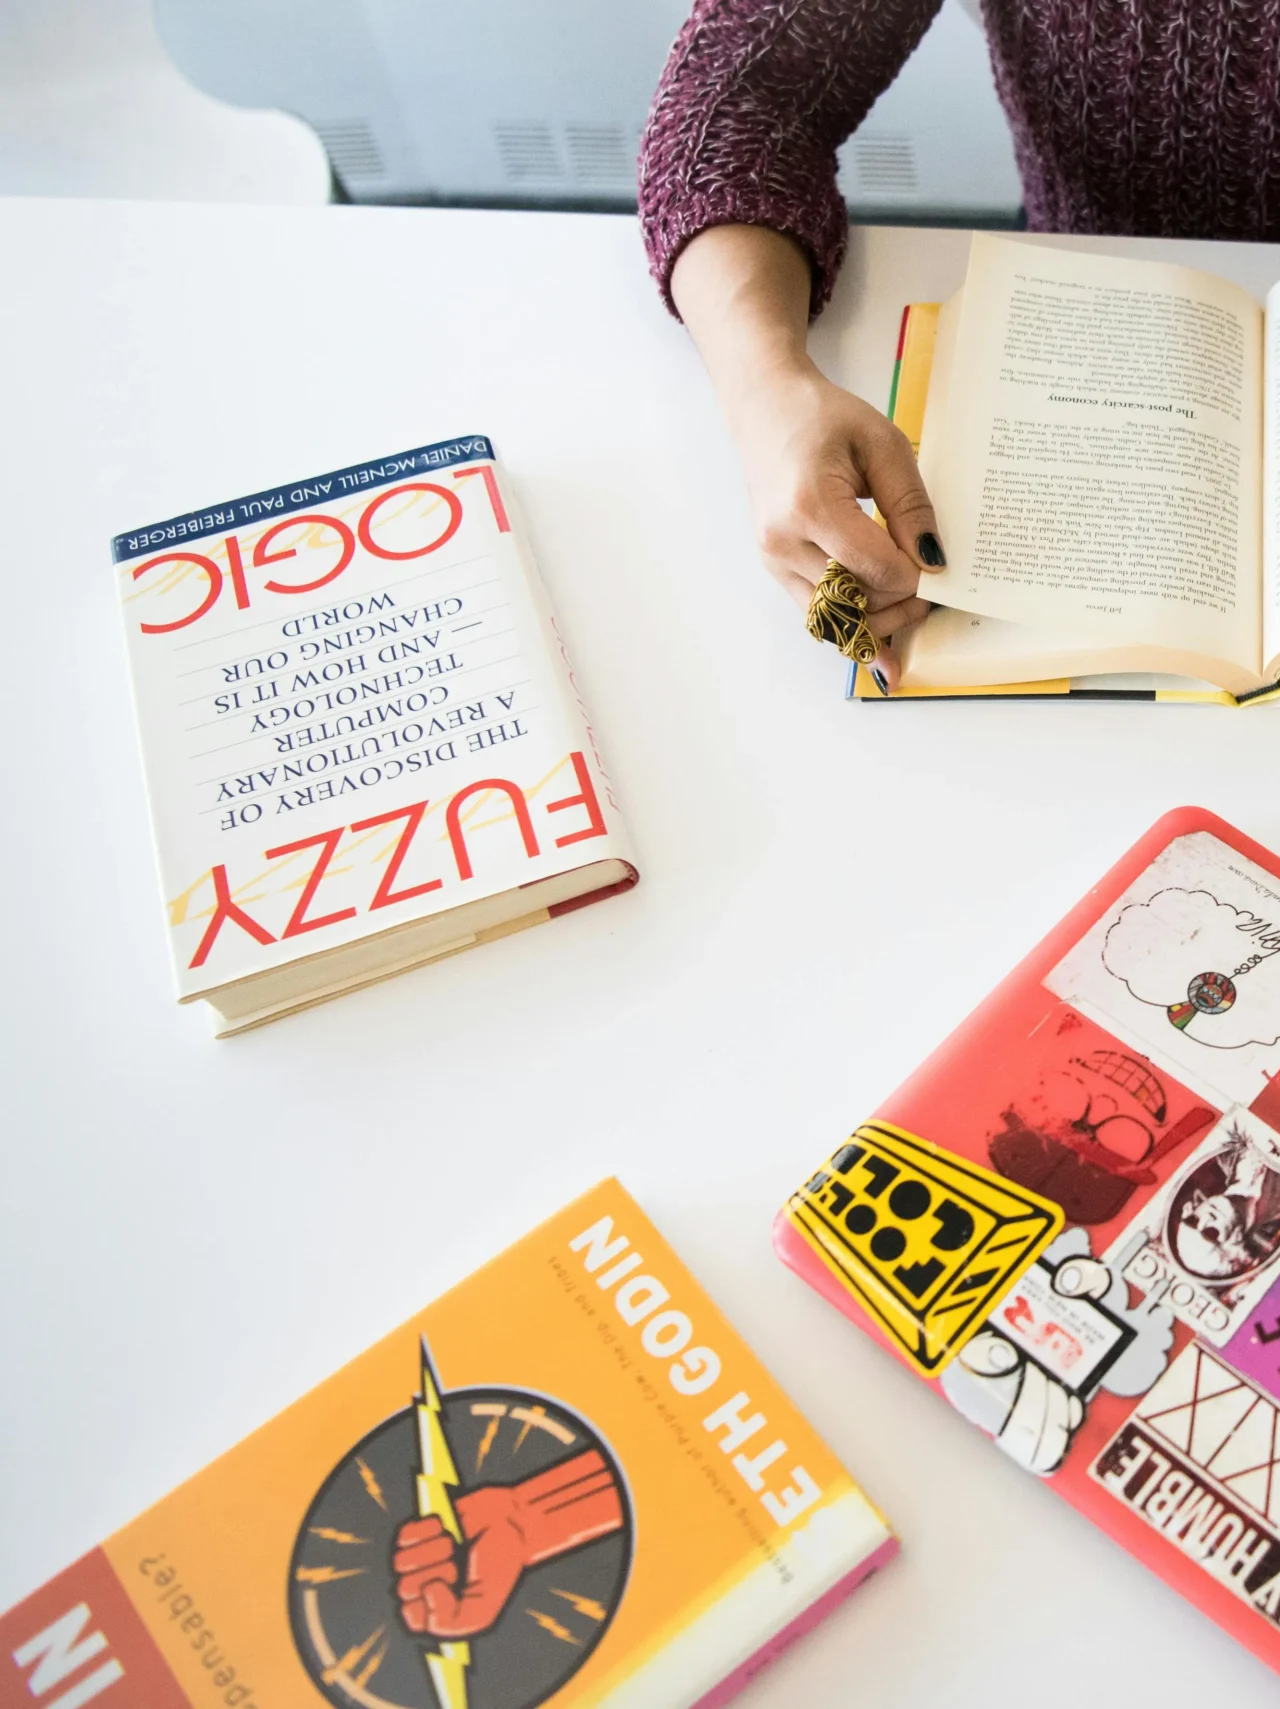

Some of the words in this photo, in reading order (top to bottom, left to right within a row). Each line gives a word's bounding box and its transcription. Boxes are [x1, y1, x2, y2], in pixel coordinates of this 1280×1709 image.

[1049, 395, 1098, 404] economy
[1102, 399, 1172, 412] post-scarcity
[1176, 408, 1194, 419] The
[418, 433, 488, 469] DANIEL
[286, 477, 335, 507] AND
[335, 453, 419, 492] MCNEILL
[236, 491, 286, 521] PAUL
[125, 506, 235, 553] FREIBERGER
[132, 465, 510, 634] LOGIC
[282, 593, 395, 637] WORLD
[1086, 604, 1107, 612] Jarvis
[300, 598, 462, 660] CHANGING
[378, 631, 440, 663] AND
[222, 652, 288, 683] OUR
[292, 655, 366, 692] HOW
[214, 692, 241, 714] IS
[251, 654, 463, 733] TECHNOLOGY
[252, 681, 278, 704] IT
[495, 691, 514, 710] A
[274, 687, 448, 753] COMPUTER
[466, 720, 528, 752] THE
[217, 702, 486, 802] REVOLUTIONARY
[276, 742, 457, 814] DISCOVERY
[221, 804, 262, 831] OF
[189, 751, 608, 969] FUZZY
[830, 1146, 975, 1251] GOLD
[801, 1166, 949, 1301] FOOL'S
[541, 1251, 583, 1296] Tribes
[569, 1215, 722, 1395] GODIN
[569, 1289, 602, 1322] and
[649, 1397, 696, 1449] Purple
[1101, 1431, 1274, 1588] HUMBLE
[131, 1543, 267, 1709] pensable?
